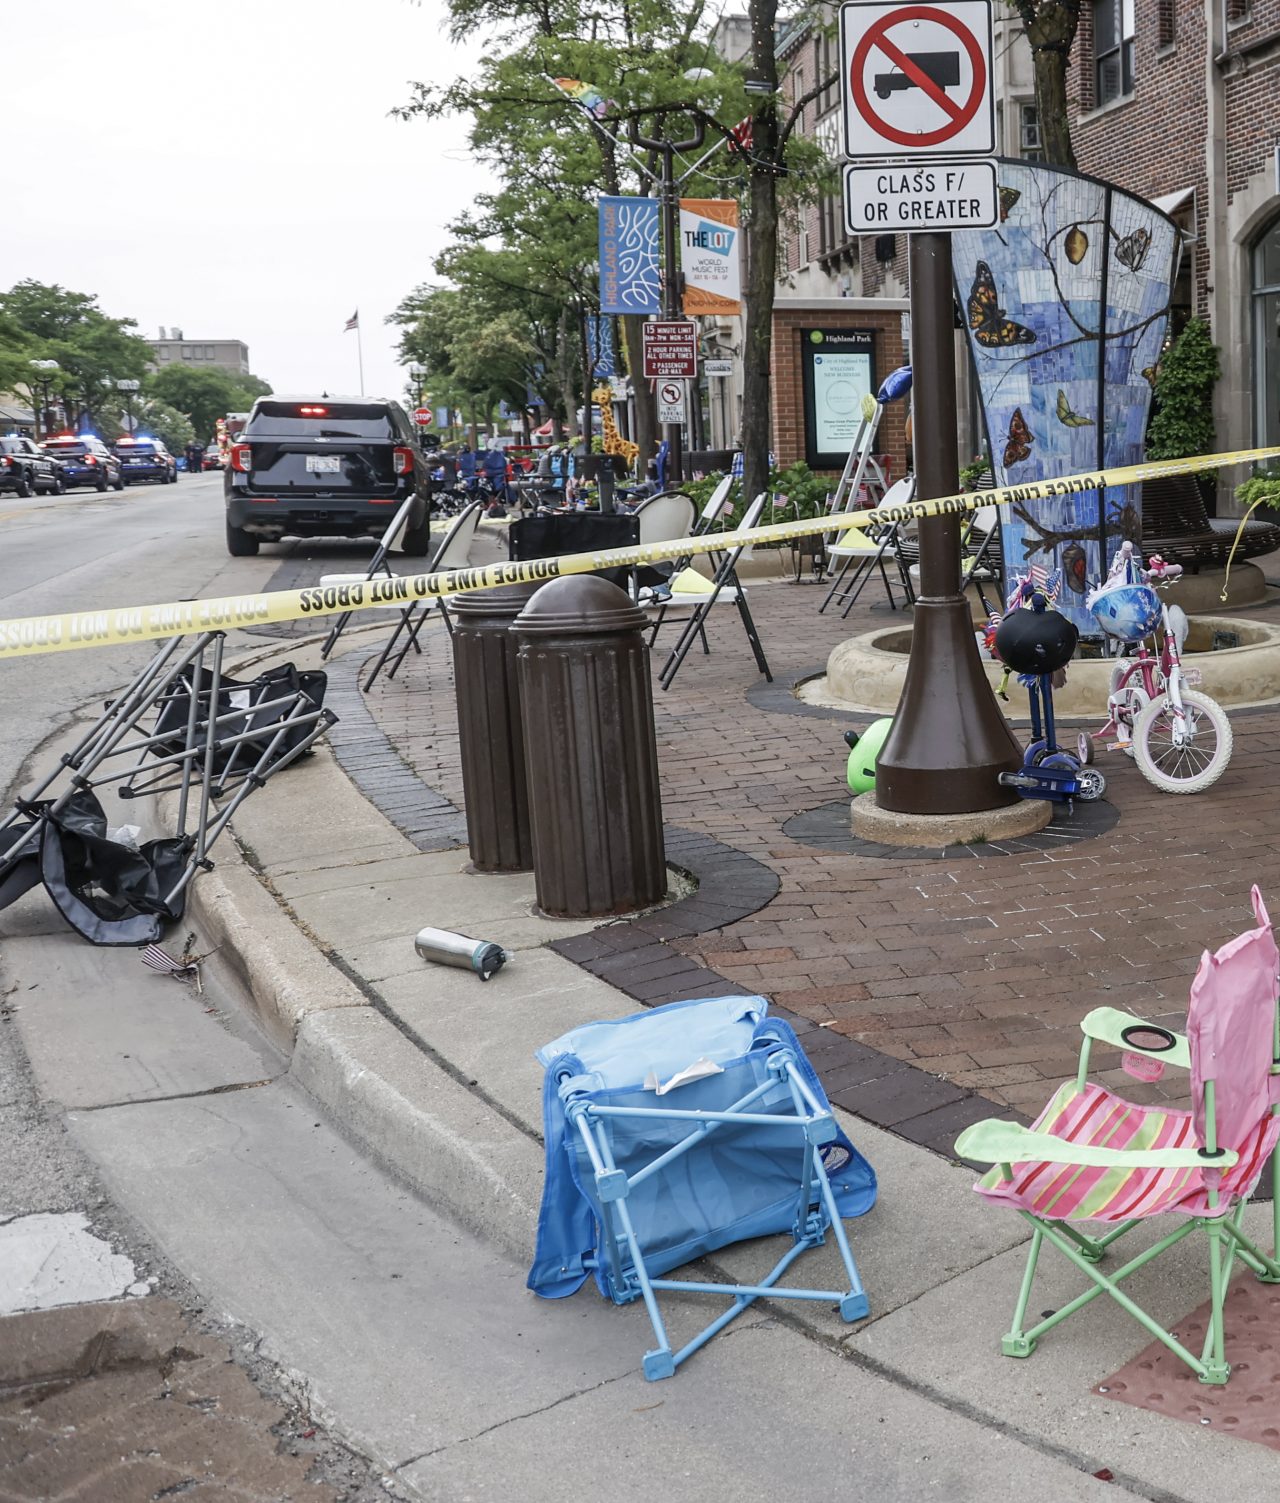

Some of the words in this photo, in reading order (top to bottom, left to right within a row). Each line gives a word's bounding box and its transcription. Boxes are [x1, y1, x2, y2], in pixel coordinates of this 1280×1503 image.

[877, 173, 936, 194] CLASS
[946, 172, 965, 191] F/
[604, 204, 616, 237] PARK
[864, 202, 888, 222] OR
[898, 199, 981, 220] GREATER
[604, 240, 617, 306] HIGHLAND
[646, 325, 655, 334] 15
[825, 335, 856, 344] Highland
[856, 335, 872, 343] Park
[414, 413, 432, 421] STOP
[32, 462, 52, 471] POLICE
[1002, 486, 1041, 503] LINE
[1046, 476, 1107, 497] POLICE
[935, 500, 968, 514] NOT
[973, 494, 998, 511] DO
[868, 504, 928, 525] CROSS
[446, 569, 488, 592] LINE
[494, 558, 561, 585] POLICE
[370, 585, 409, 603] NOT
[413, 575, 440, 597] DO
[300, 583, 364, 612] CROSS
[150, 605, 193, 631] LINE
[200, 600, 269, 626] POLICE
[0, 619, 62, 650] CROSS
[69, 618, 109, 643] NOT
[117, 614, 143, 637] DO
